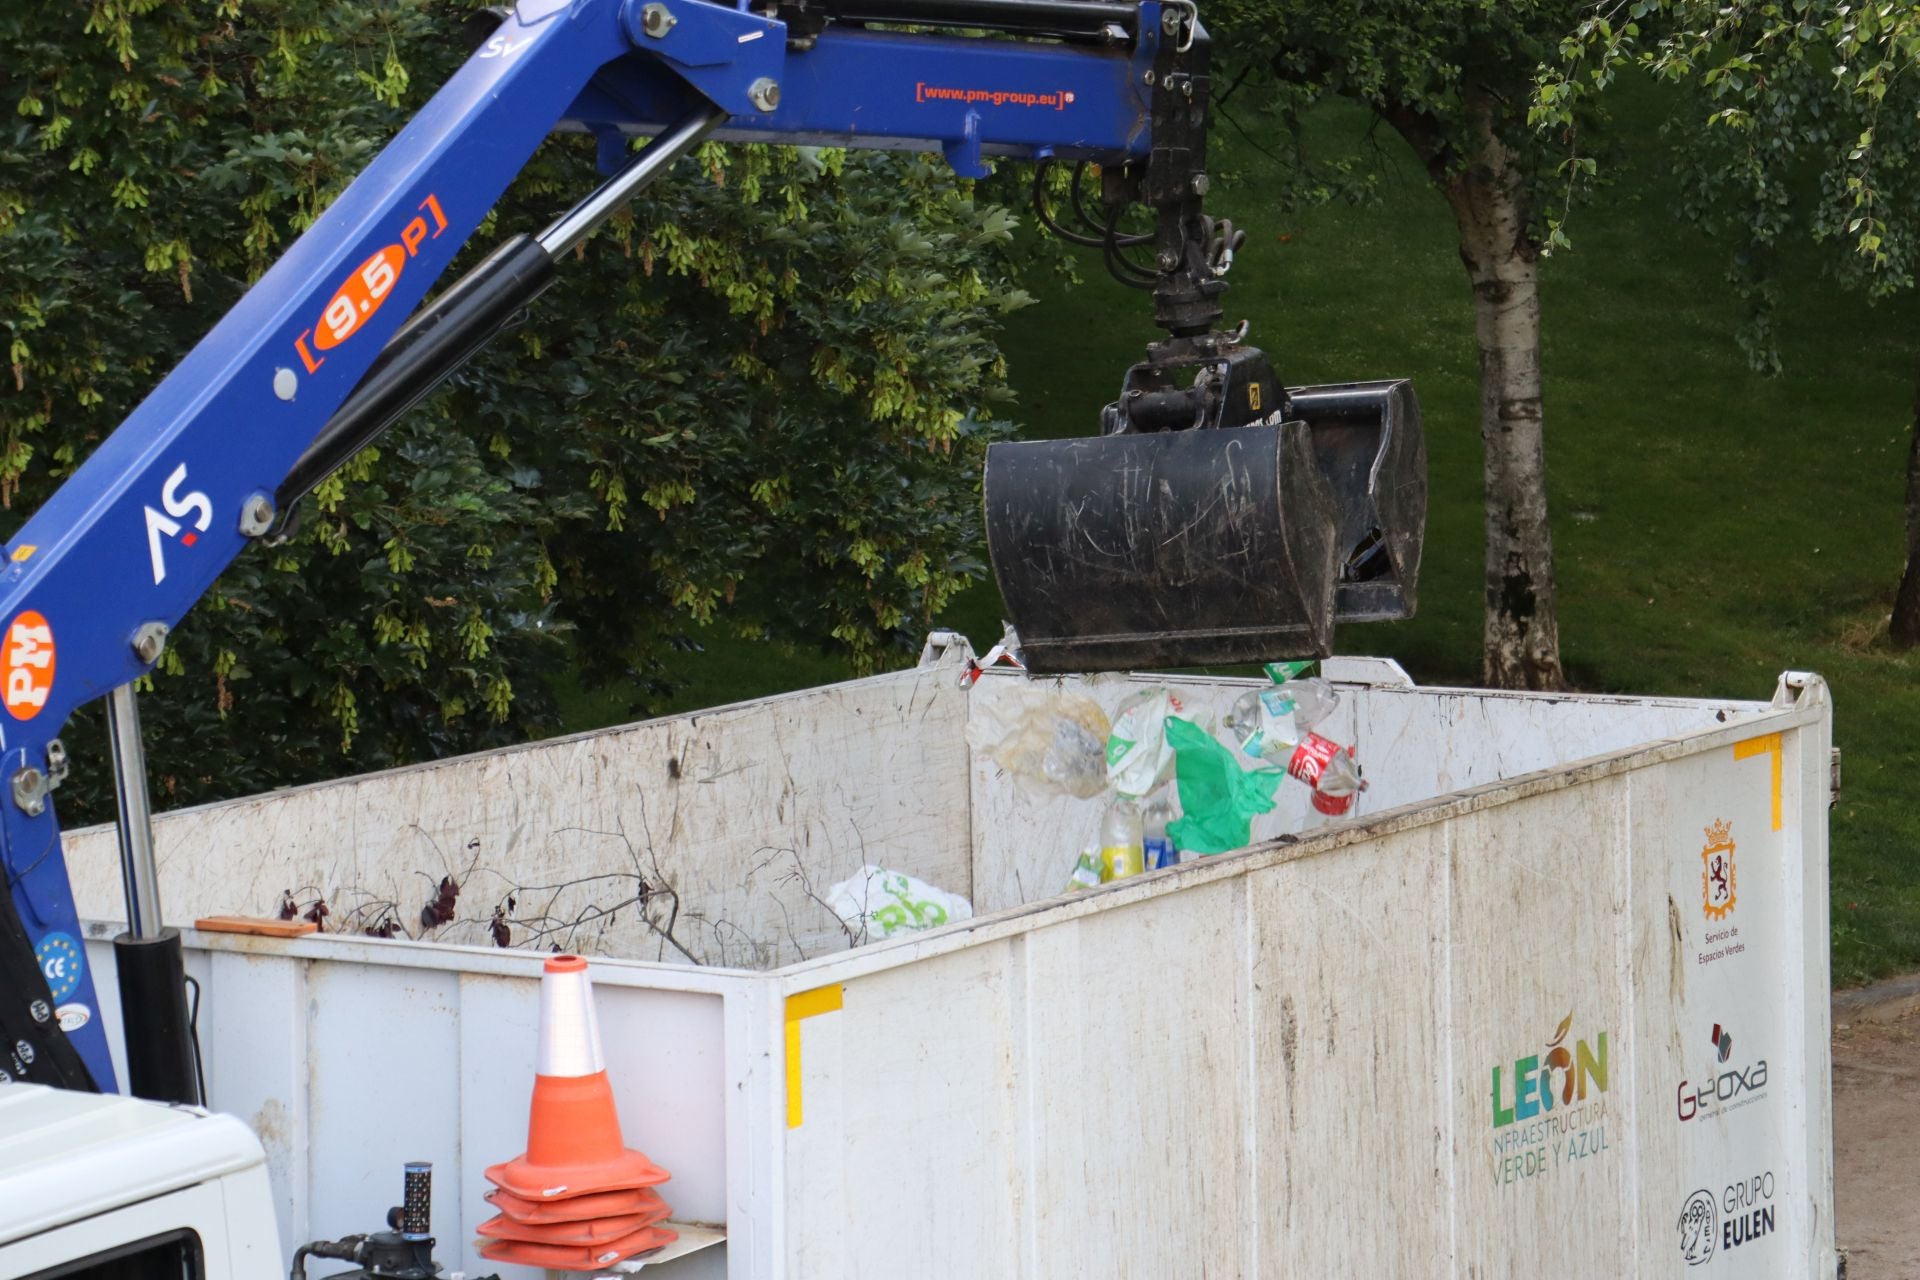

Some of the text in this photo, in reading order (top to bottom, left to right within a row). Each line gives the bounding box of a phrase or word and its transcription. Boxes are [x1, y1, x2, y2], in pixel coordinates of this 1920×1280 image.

[7, 624, 53, 707] PM
[1698, 942, 1744, 966] Espacios Verdes
[1705, 925, 1738, 944] Servicio de
[45, 957, 65, 979] CE
[1678, 1060, 1767, 1121] Geoxa
[1493, 1102, 1609, 1154] NFRAESTRUCTURA
[1493, 1126, 1609, 1188] VERDE Y AZUL
[1723, 1171, 1774, 1214] GRUPO
[1723, 1204, 1775, 1251] EULEN
